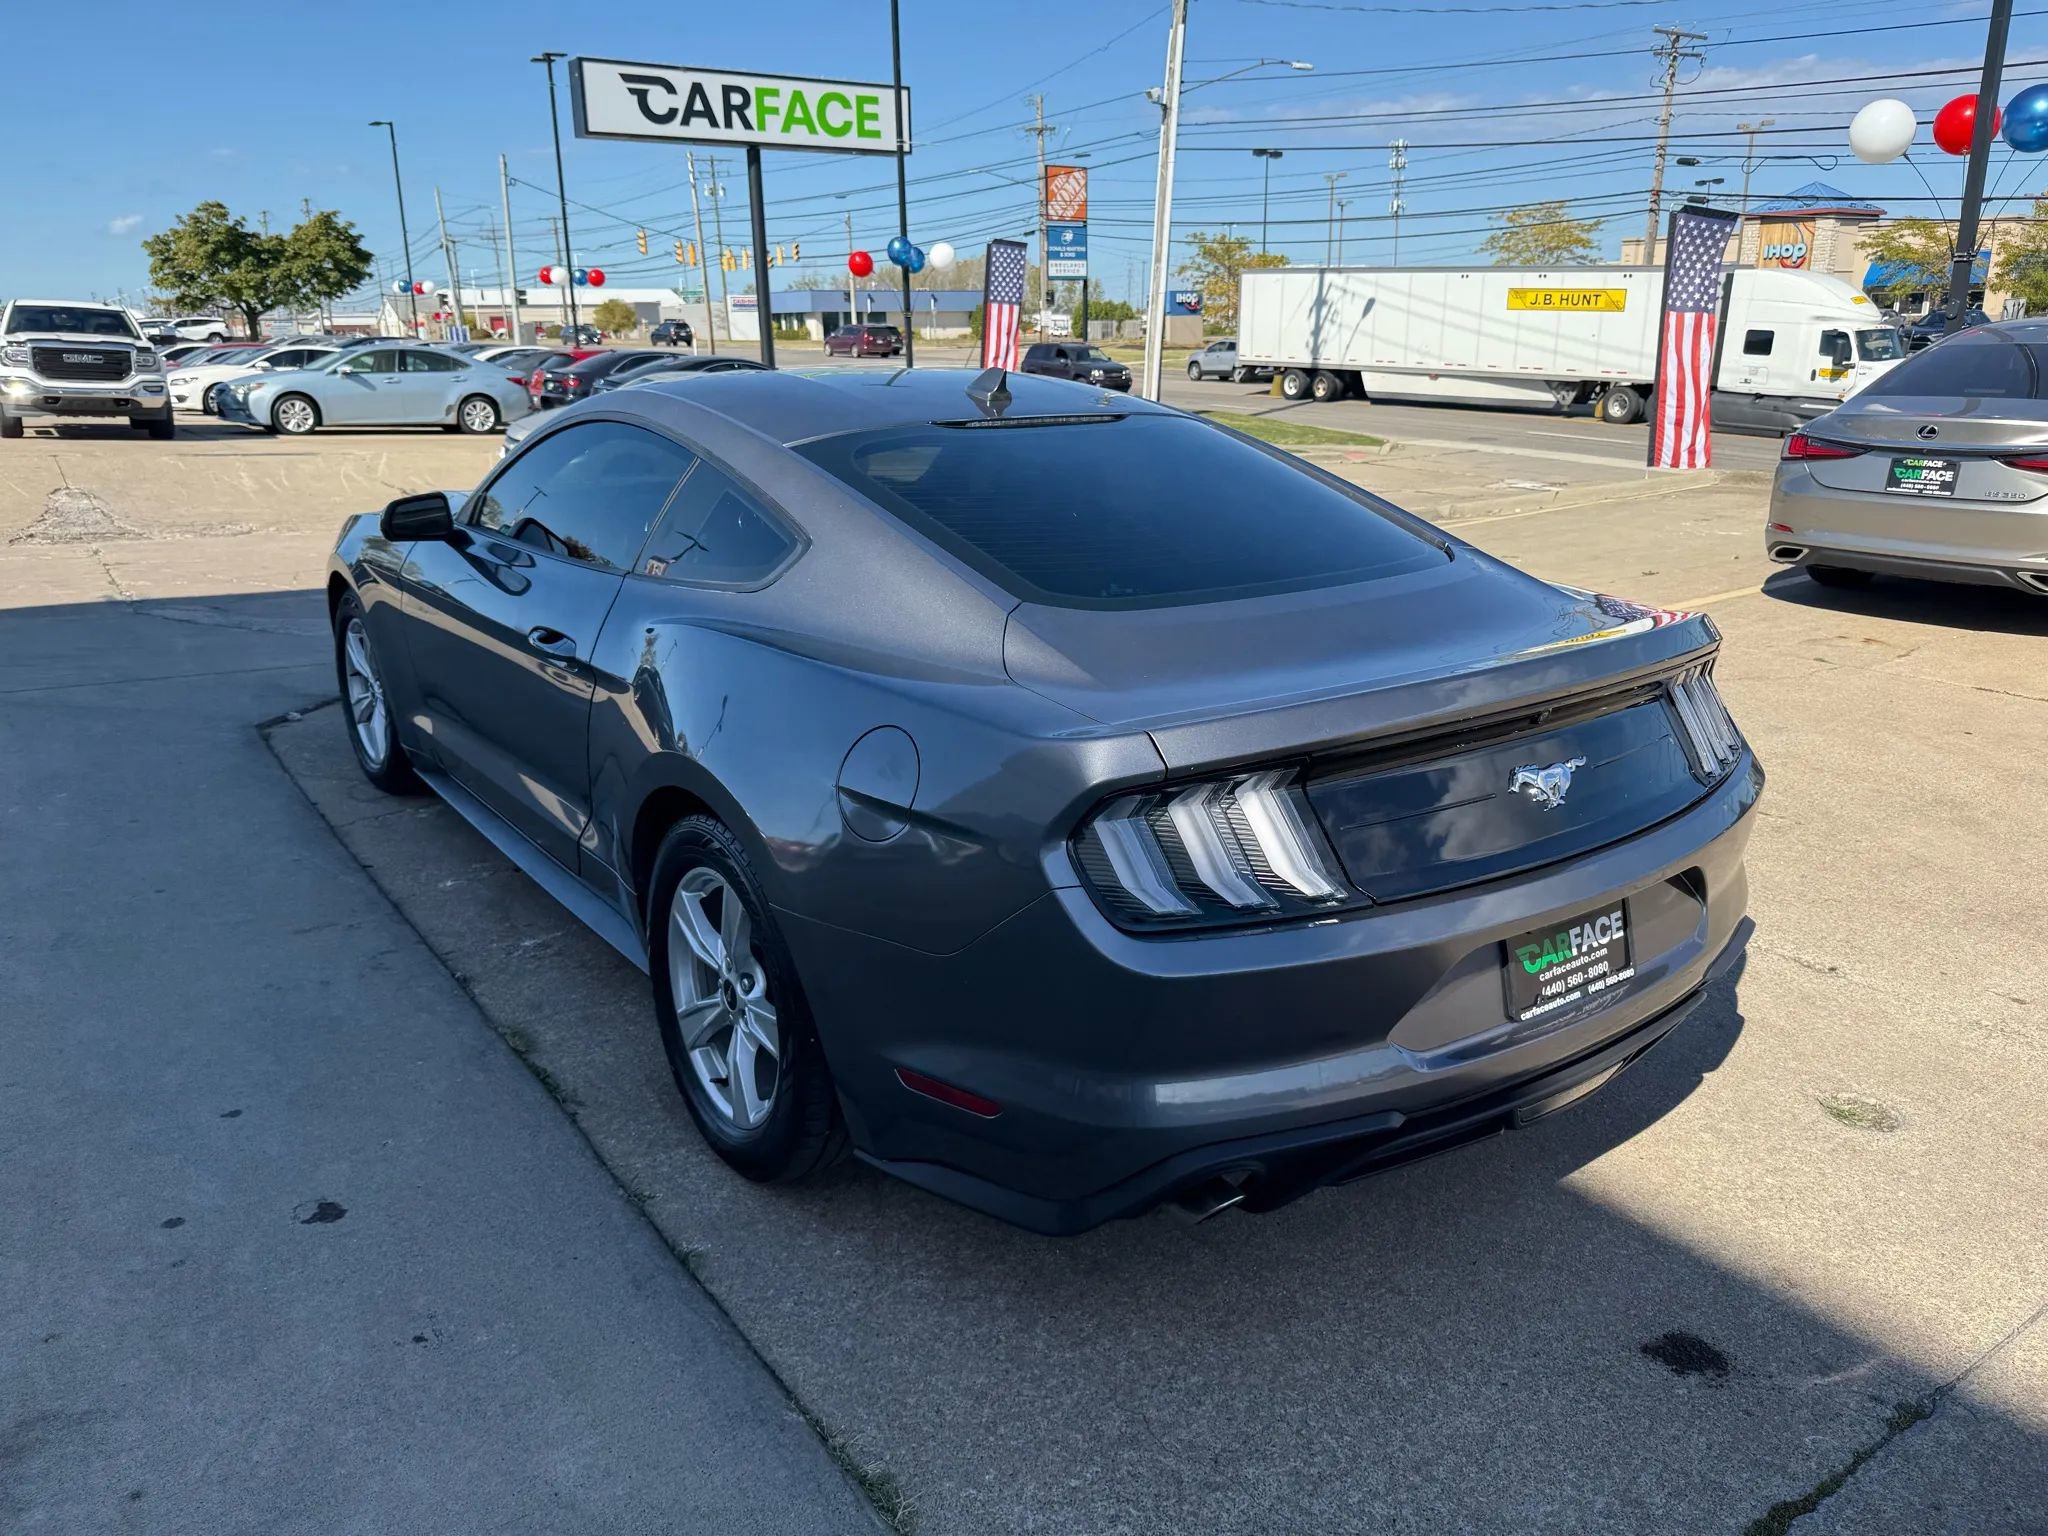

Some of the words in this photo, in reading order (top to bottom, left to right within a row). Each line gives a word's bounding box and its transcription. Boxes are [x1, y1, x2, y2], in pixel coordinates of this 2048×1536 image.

[618, 73, 881, 139] CARFACE
[1559, 294, 1602, 307] HUNT
[63, 354, 104, 364] GMC
[1894, 468, 1954, 482] CARFACE
[1515, 910, 1625, 974] CARFACE
[1539, 947, 1608, 982] carfaceauto.com
[1541, 979, 1566, 997] (440)
